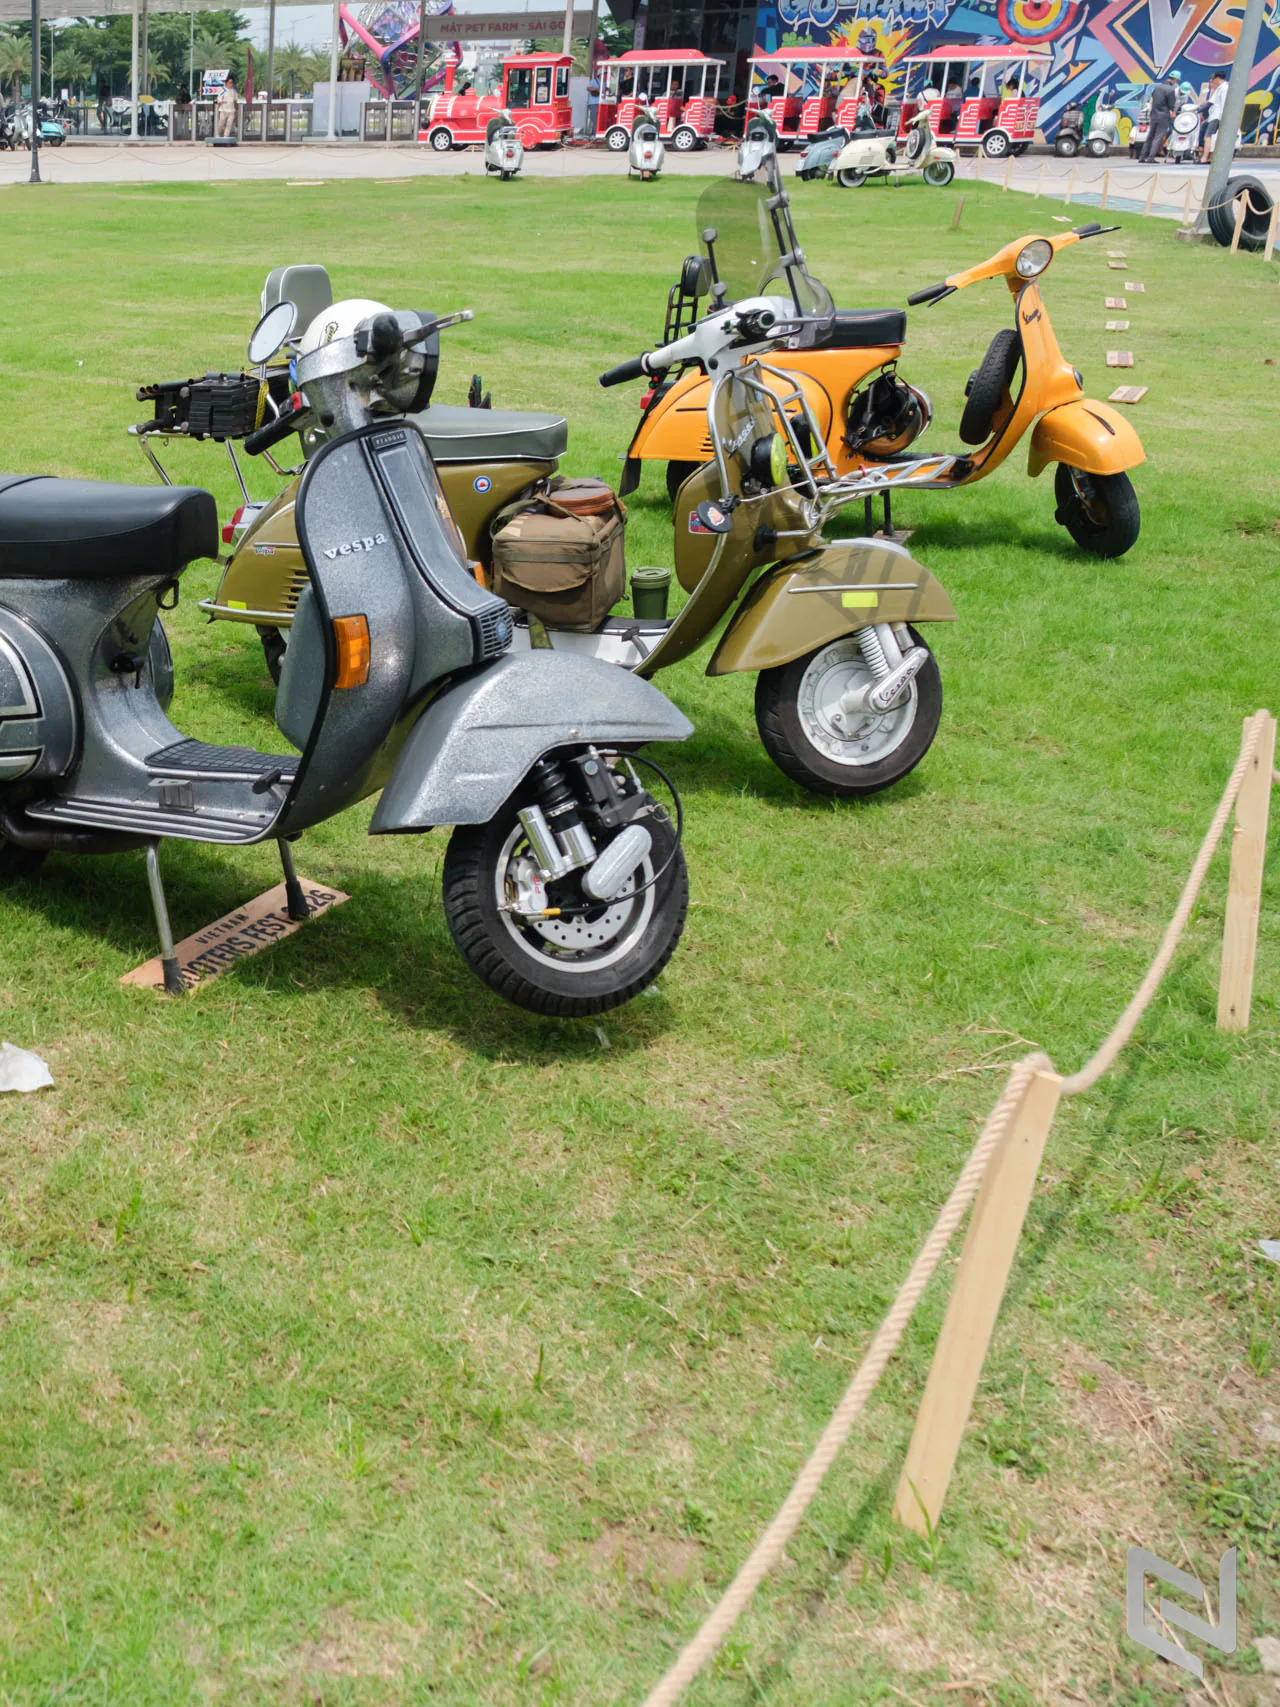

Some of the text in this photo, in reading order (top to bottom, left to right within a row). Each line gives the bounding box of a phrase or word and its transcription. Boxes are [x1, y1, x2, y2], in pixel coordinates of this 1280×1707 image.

[465, 23, 484, 32] PET
[488, 22, 518, 31] FARM
[195, 913, 250, 944] VIETNAM
[240, 912, 295, 943] FEST
